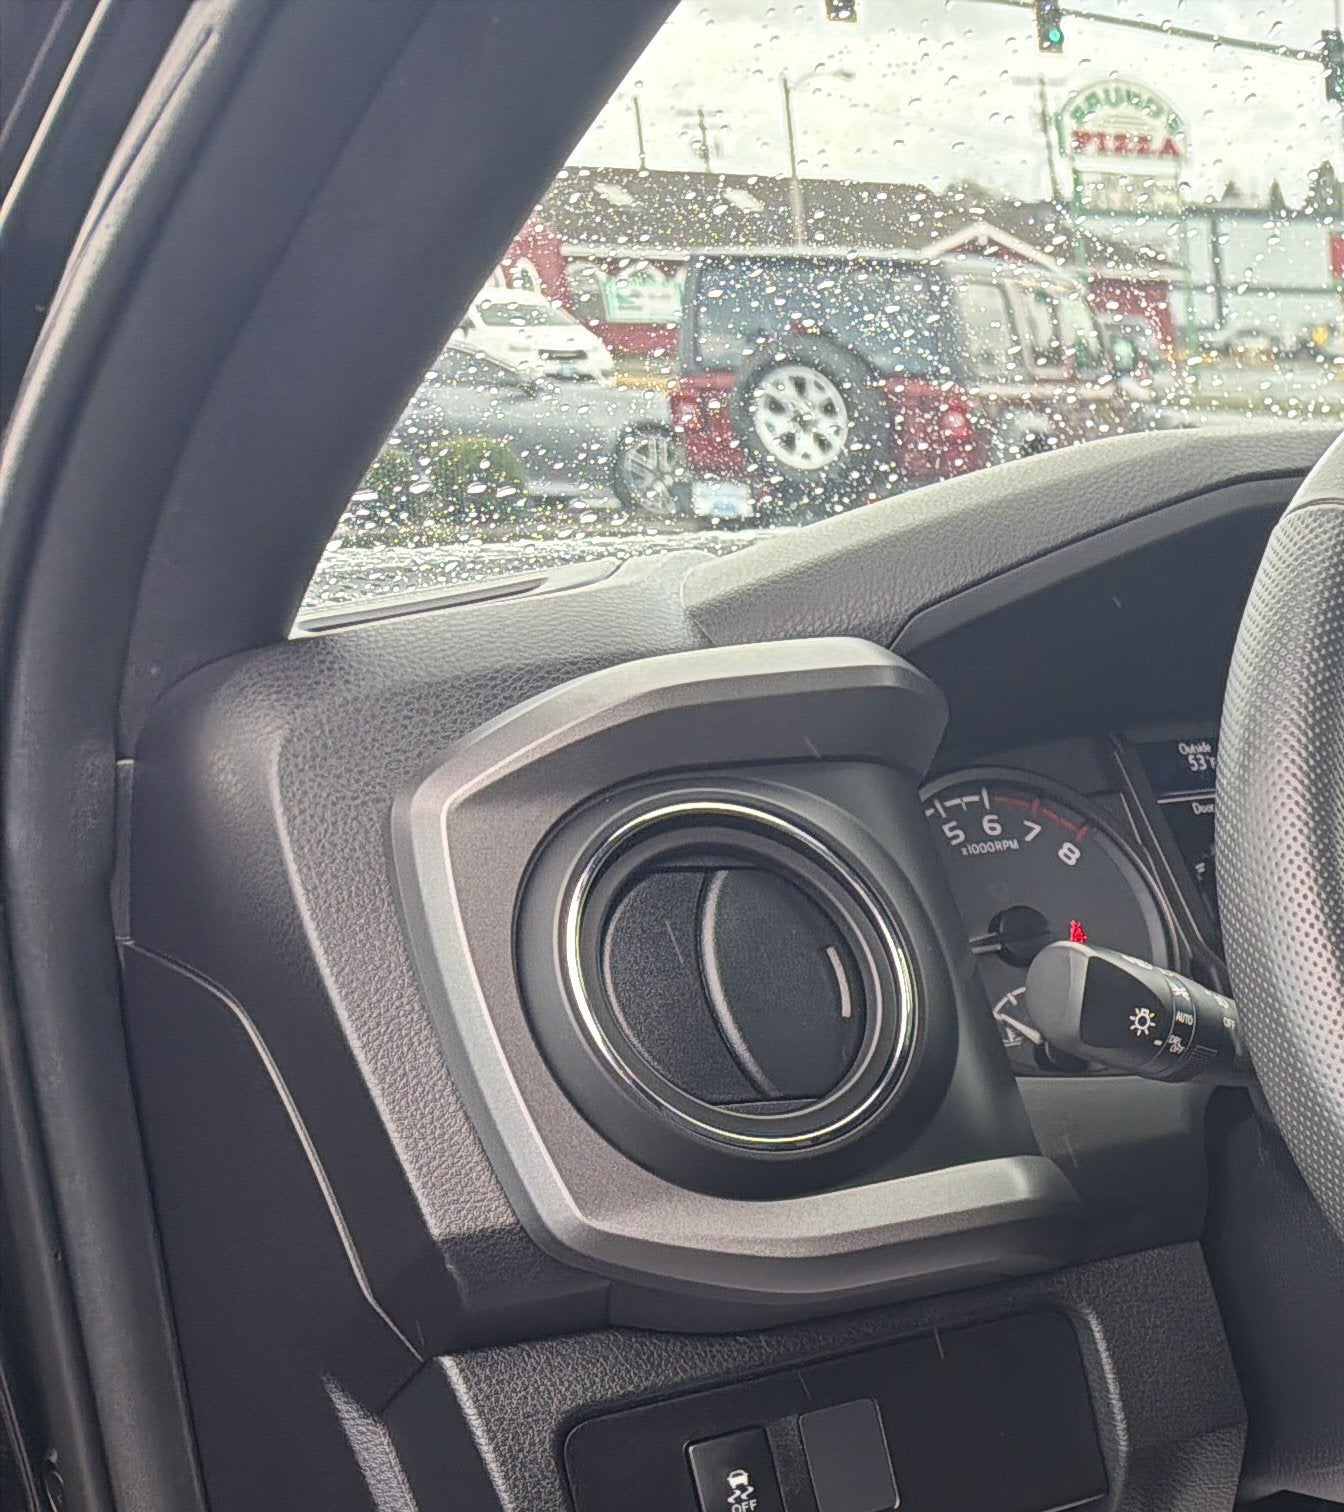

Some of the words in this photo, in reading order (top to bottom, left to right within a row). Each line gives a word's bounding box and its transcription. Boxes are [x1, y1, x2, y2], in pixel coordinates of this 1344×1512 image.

[1071, 130, 1182, 158] PIZZA
[1178, 742, 1212, 755] Outside
[942, 820, 966, 846] 5
[982, 814, 1003, 836] 6
[1023, 819, 1042, 842] 7
[1057, 841, 1081, 866] 8
[1176, 1012, 1193, 1026] AUTO
[1223, 1017, 1236, 1030] OFF
[1169, 1044, 1185, 1055] OFF
